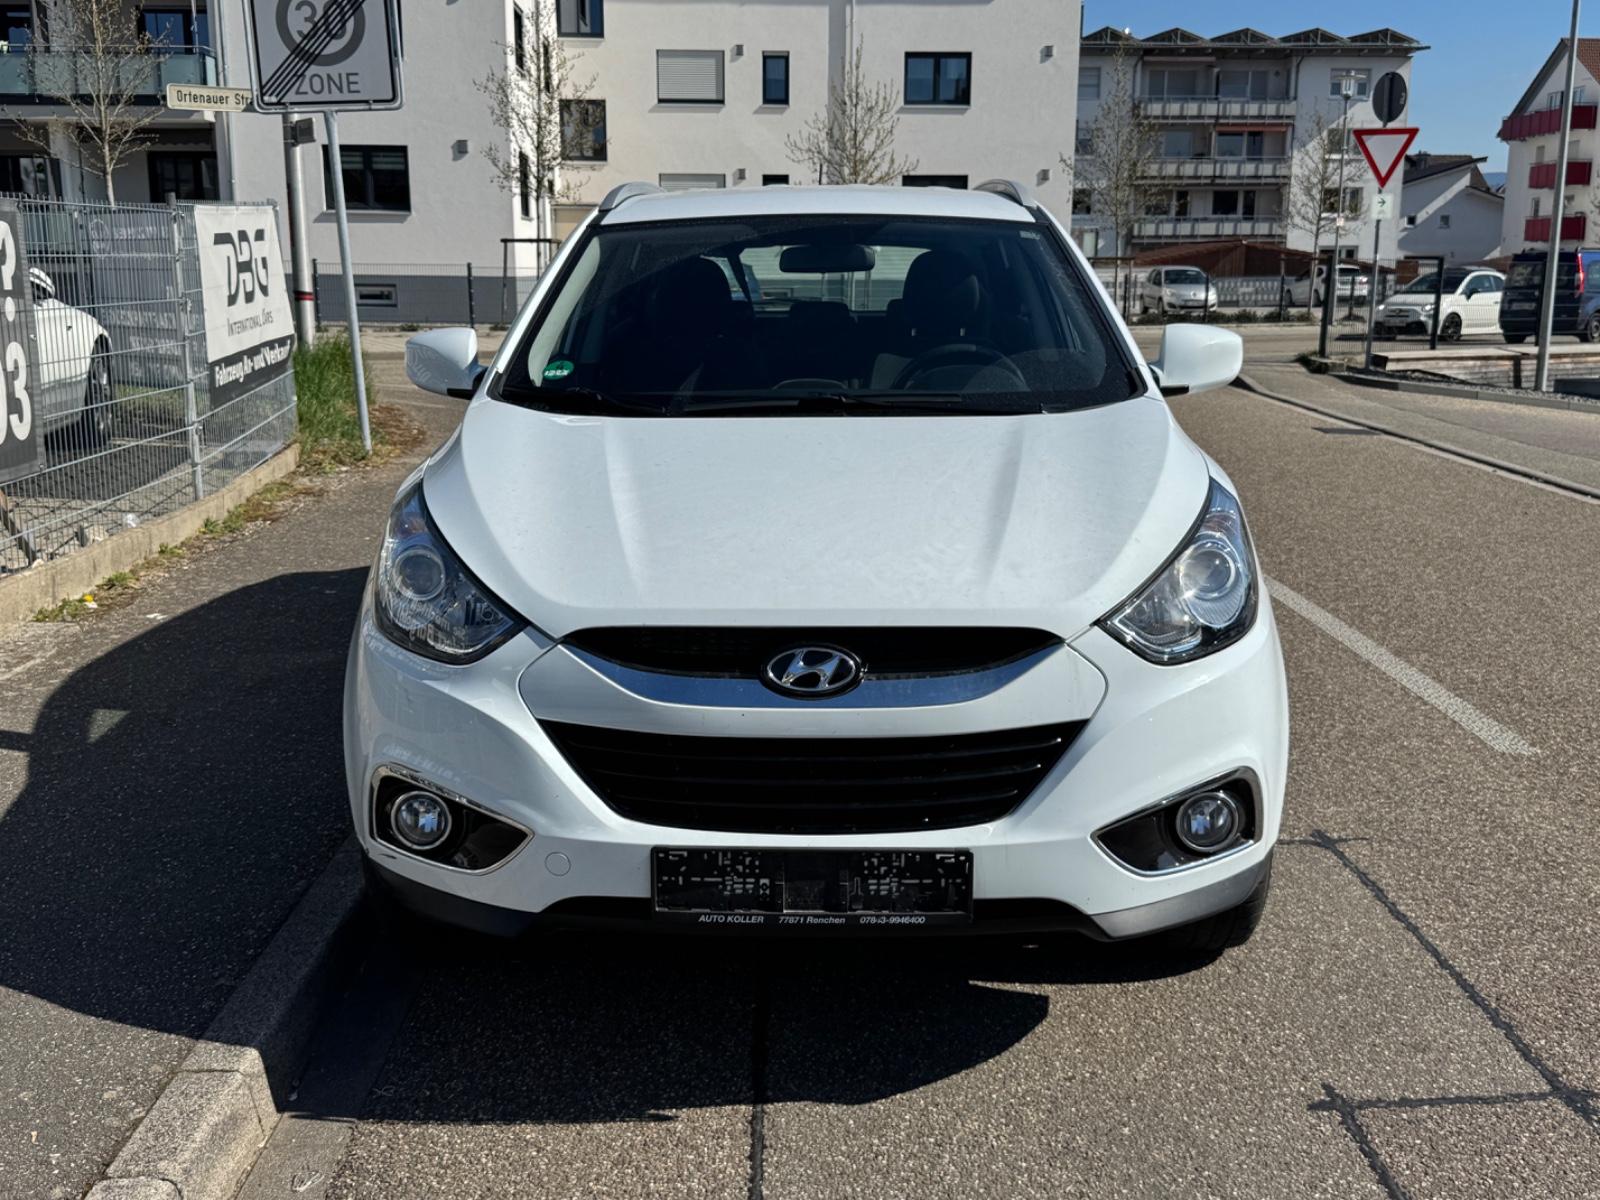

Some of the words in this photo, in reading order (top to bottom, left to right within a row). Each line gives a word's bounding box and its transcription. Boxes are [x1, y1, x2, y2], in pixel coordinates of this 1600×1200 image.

[294, 72, 361, 95] ZONE
[176, 90, 230, 104] Ortenauer
[213, 228, 269, 307] DBG
[727, 915, 764, 924] KOLLER
[779, 916, 804, 924] 77871
[806, 916, 846, 924] Renchen
